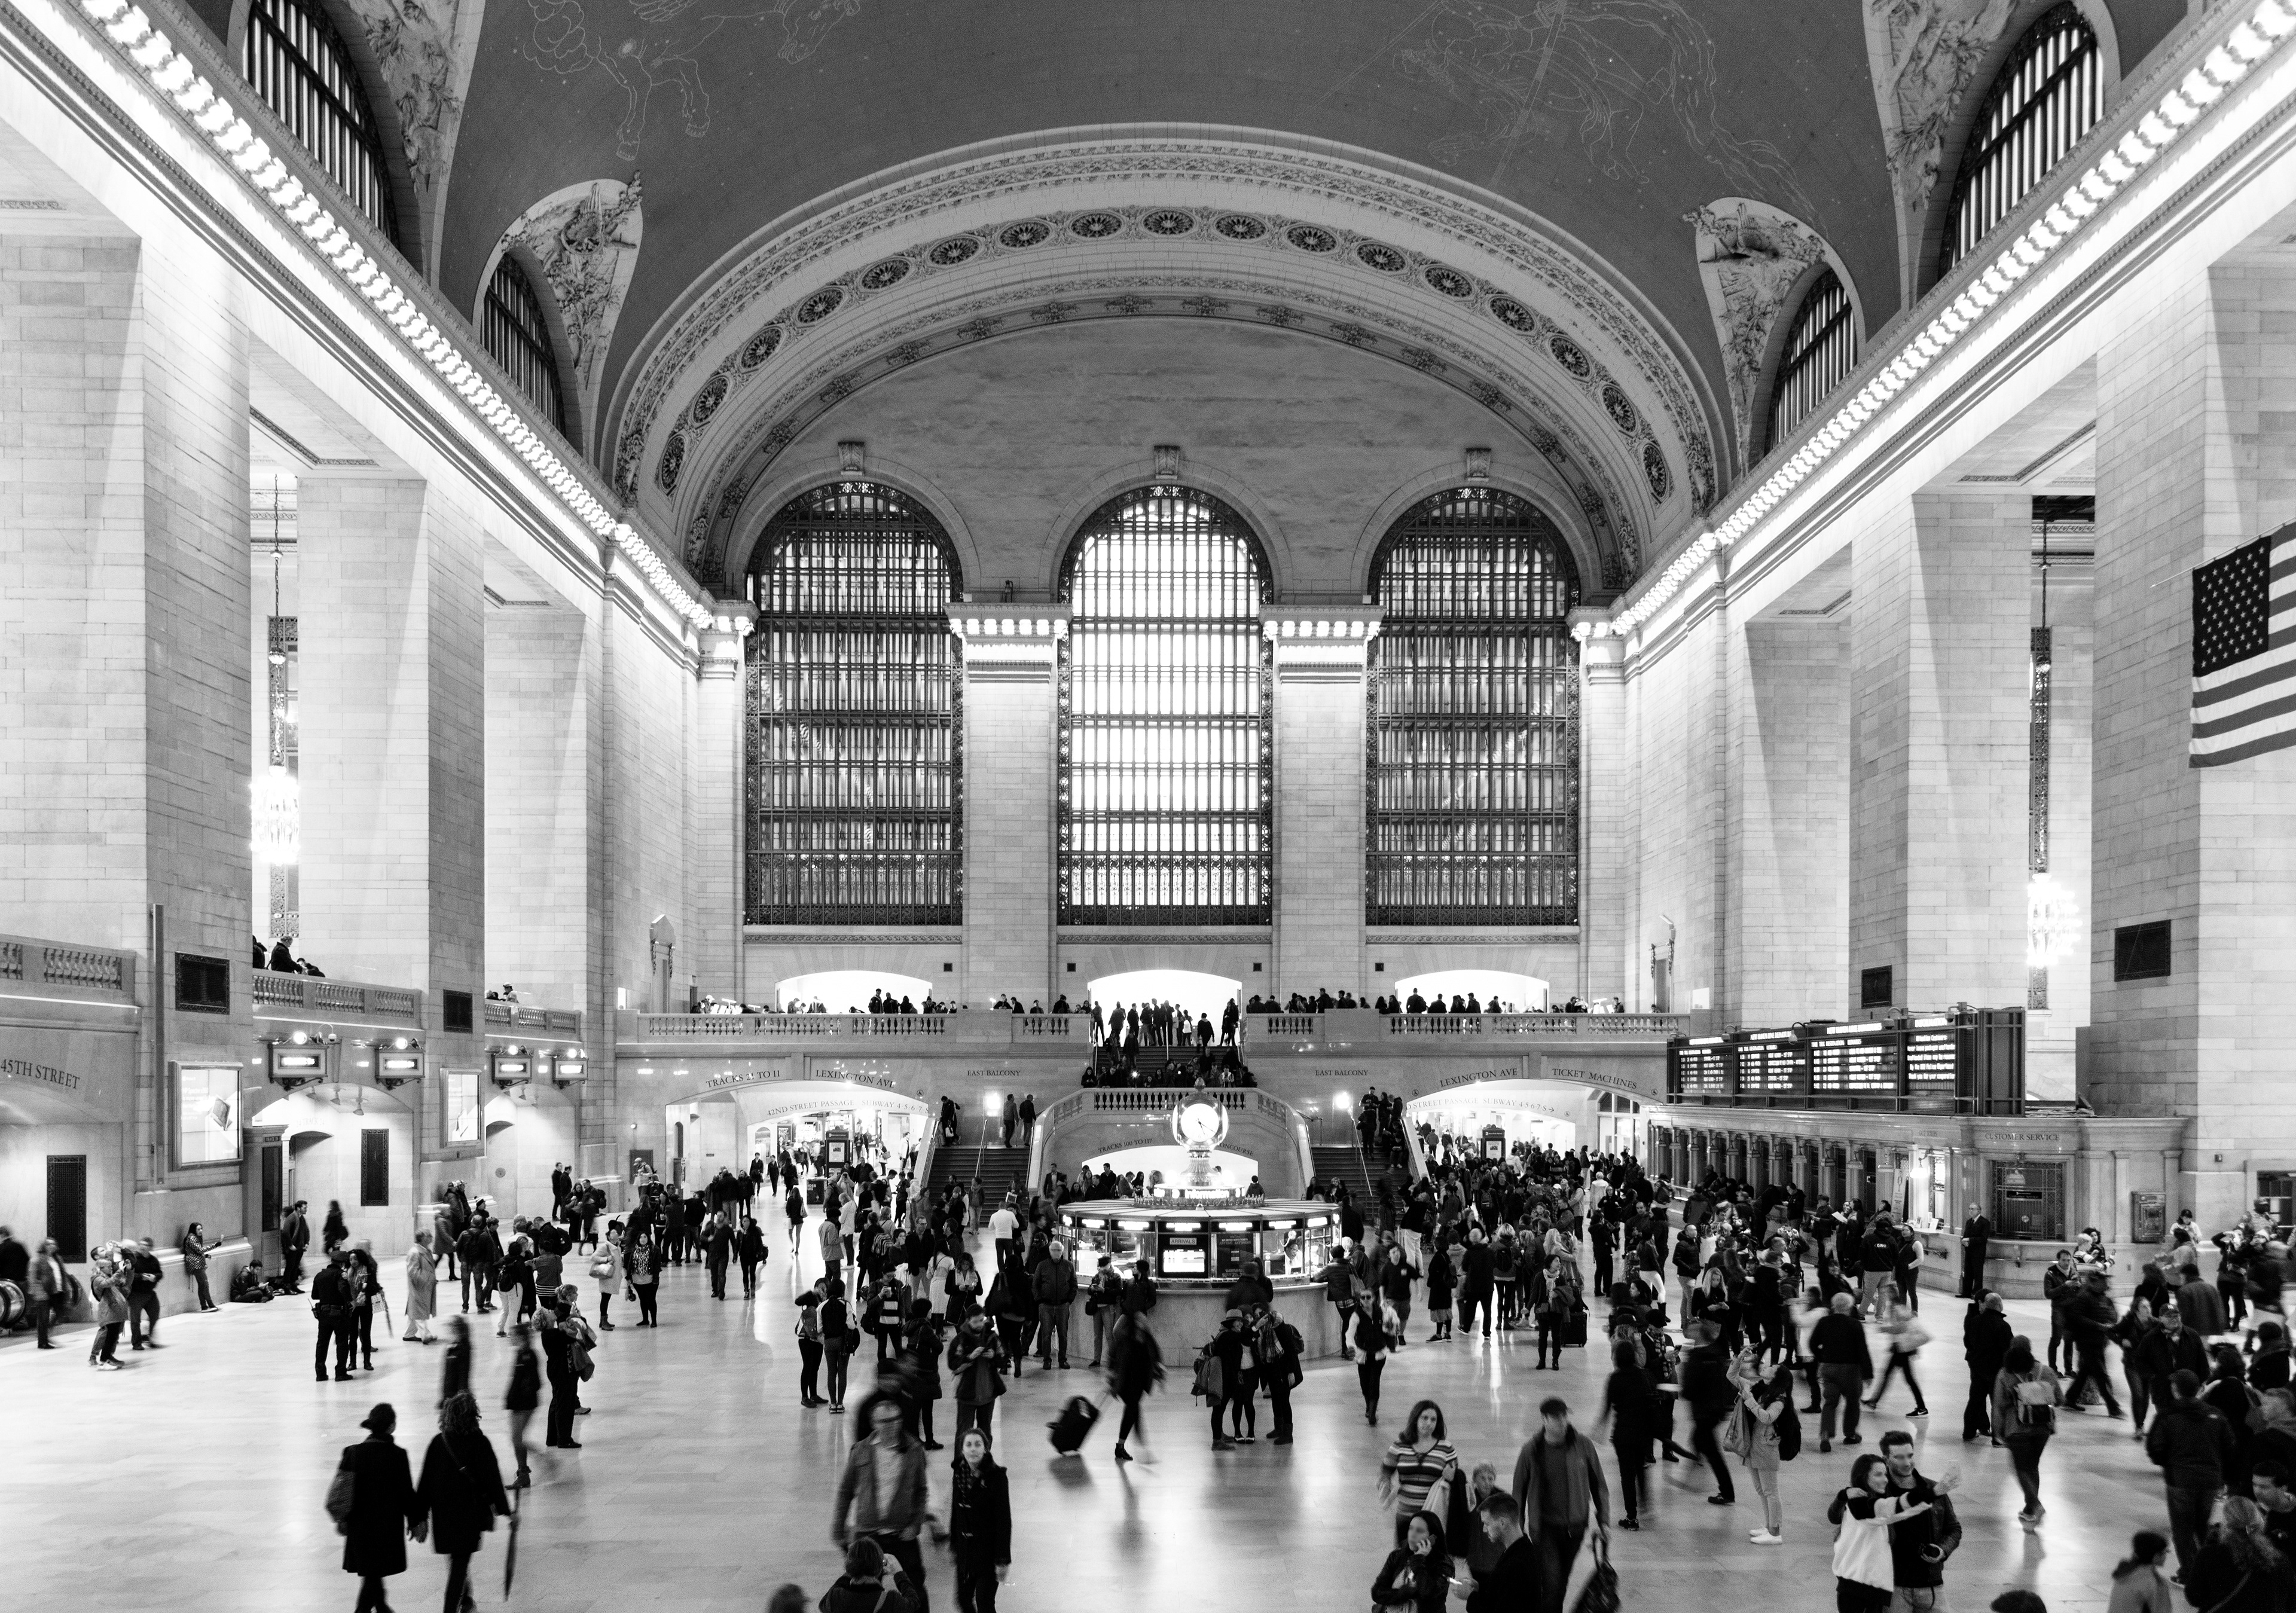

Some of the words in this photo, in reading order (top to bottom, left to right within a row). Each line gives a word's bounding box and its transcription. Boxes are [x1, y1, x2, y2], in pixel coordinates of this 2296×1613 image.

[1, 1059, 33, 1076] 45TH
[35, 1064, 80, 1089] STREET
[706, 1074, 744, 1088] TRACKS
[816, 1070, 874, 1085] LEXINGTON
[877, 1078, 895, 1089] AVE
[1440, 1070, 1497, 1087] LEXINGTON
[1500, 1068, 1518, 1077] AVE
[1552, 1068, 1585, 1078] TICKET
[1589, 1072, 1637, 1089] MACHINES
[767, 1106, 788, 1116] 42ND
[789, 1102, 818, 1111] STREET
[1413, 1099, 1443, 1110] STREET
[1483, 1098, 1517, 1106] SUBWAY
[1098, 1143, 1123, 1153] TRACKS
